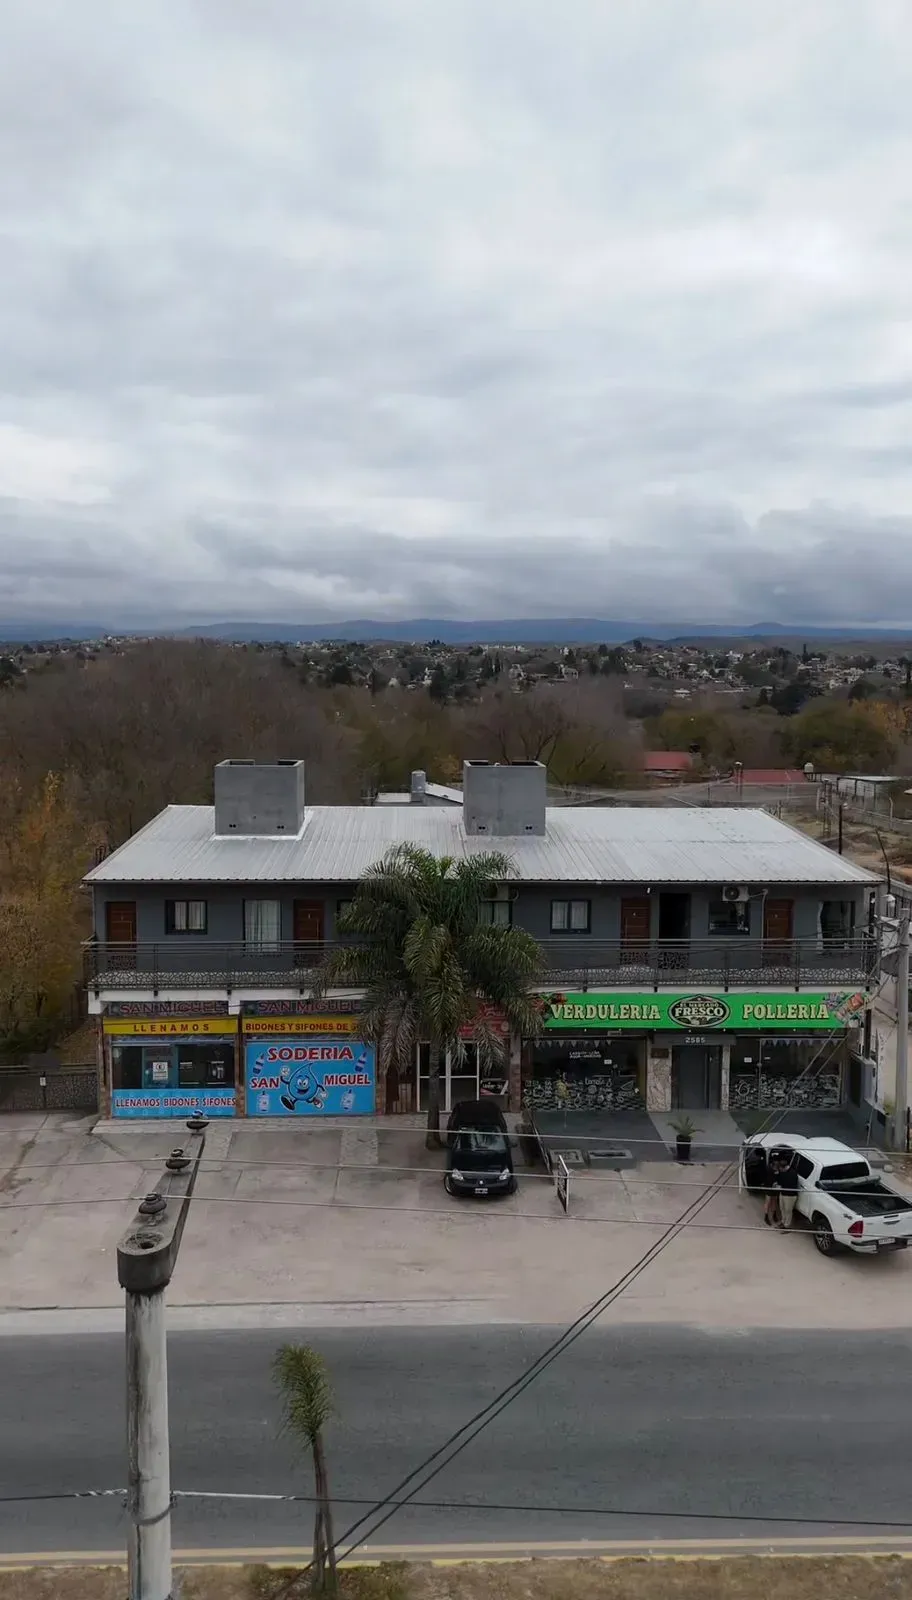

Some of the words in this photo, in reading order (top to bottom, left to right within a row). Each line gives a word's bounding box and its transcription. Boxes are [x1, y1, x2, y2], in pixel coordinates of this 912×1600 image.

[550, 1003, 661, 1020] VERDULERIA
[675, 1007, 724, 1017] FRESCO
[743, 1004, 830, 1020] POLLERIA
[133, 1024, 210, 1032] LLENAMOS
[245, 1023, 286, 1031] BIDONES
[288, 1023, 294, 1031] Y
[295, 1023, 334, 1031] SIFONES
[336, 1023, 349, 1031] DE
[267, 1046, 354, 1062] SODERIA
[250, 1077, 280, 1090] SAN
[323, 1074, 371, 1086] MIGUEL
[115, 1098, 160, 1107] LLENAMOS
[163, 1098, 200, 1107] BIDONES
[202, 1098, 236, 1107] SIFONES
